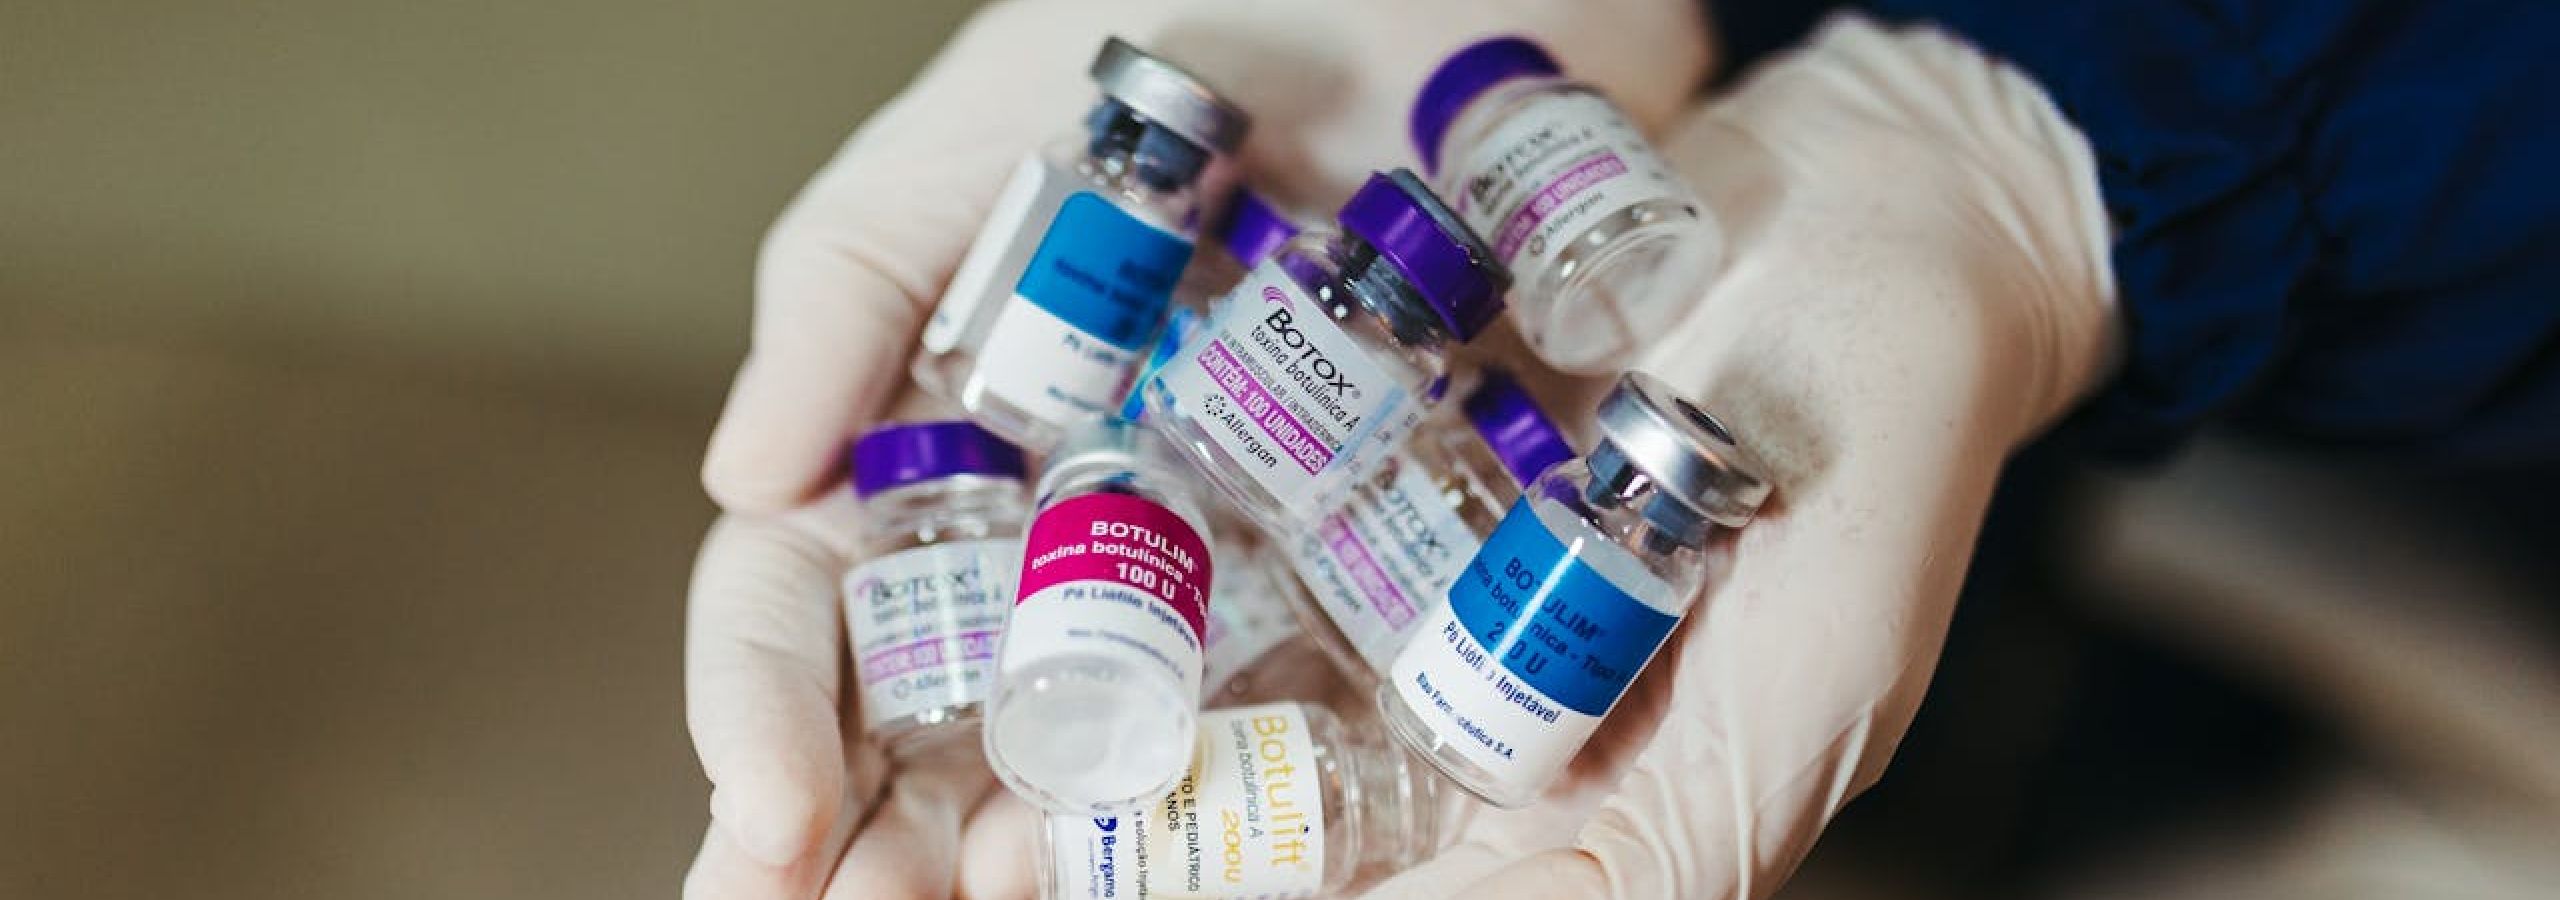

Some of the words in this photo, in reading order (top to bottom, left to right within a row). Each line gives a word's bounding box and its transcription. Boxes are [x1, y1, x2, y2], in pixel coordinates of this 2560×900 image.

[1251, 325, 1289, 366] toxina
[1286, 356, 1348, 424] botulínica
[1344, 415, 1360, 432] A
[1219, 410, 1278, 469] Allergan
[1249, 391, 1270, 419] 100
[1265, 408, 1327, 472] UNIDADES
[1031, 543, 1087, 570] toxina
[1091, 539, 1184, 584] botulínica
[1116, 562, 1158, 590] 100
[1161, 579, 1177, 601] U
[1503, 556, 1600, 642] BOULIM
[1443, 620, 1459, 644] Pó
[1495, 675, 1562, 725] Injetável
[1486, 620, 1528, 661] 20
[1524, 651, 1549, 675] U
[1100, 835, 1117, 898] Bergamo
